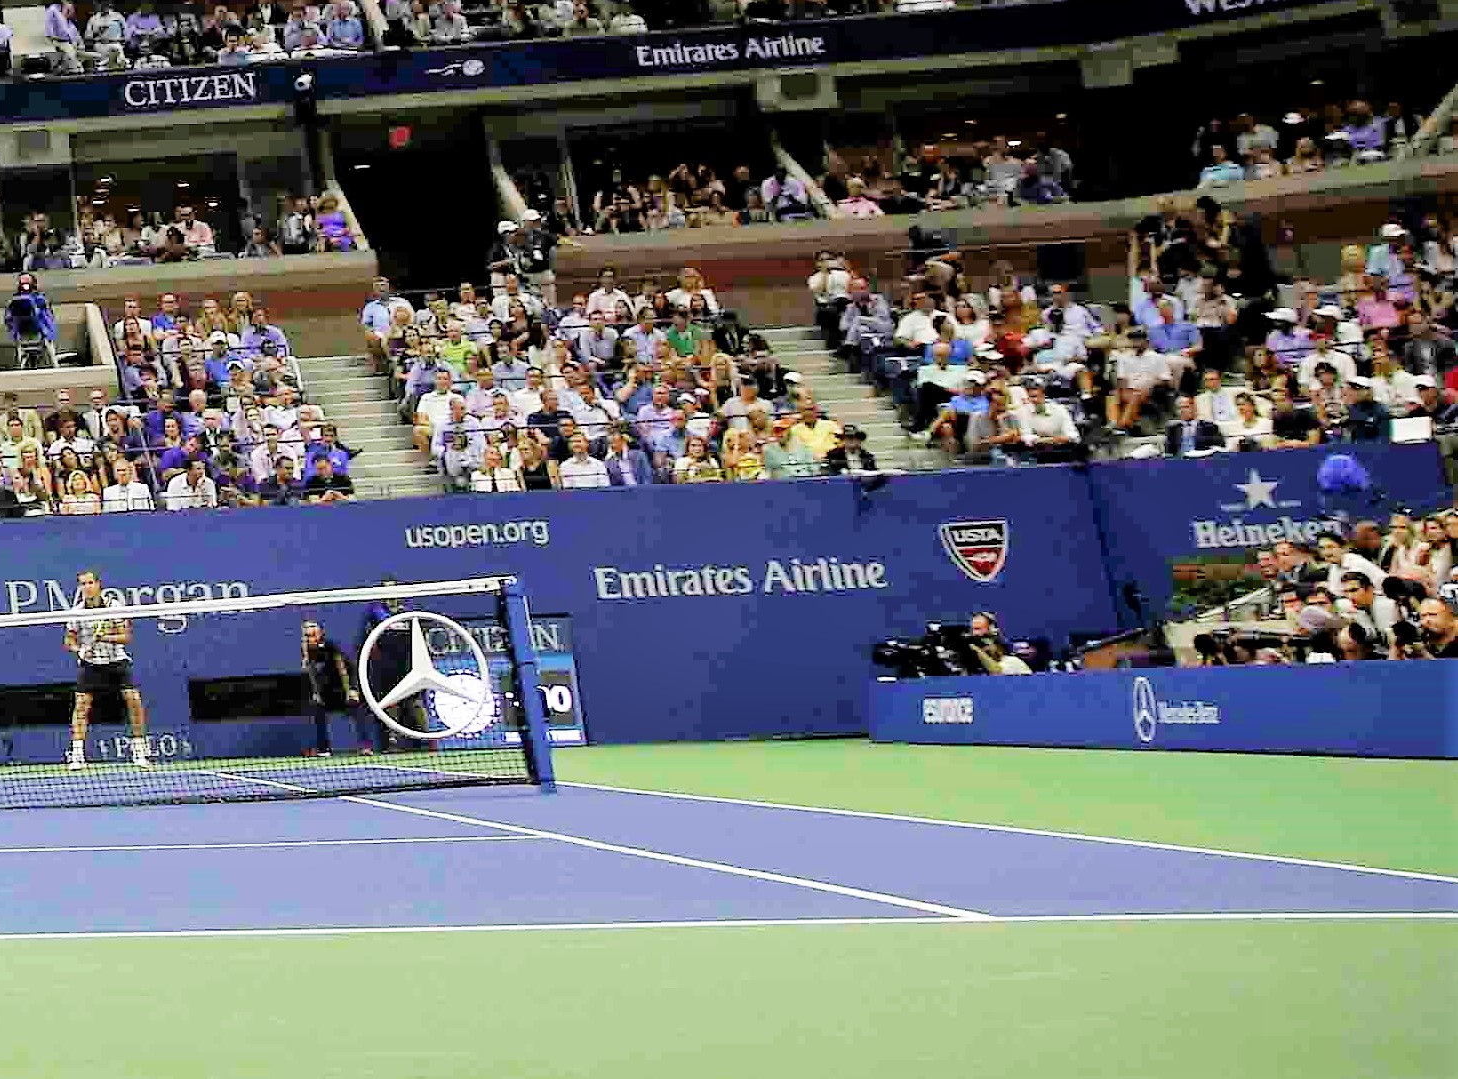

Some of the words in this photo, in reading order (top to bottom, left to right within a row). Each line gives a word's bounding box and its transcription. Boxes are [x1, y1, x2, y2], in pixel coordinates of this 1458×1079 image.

[636, 42, 740, 68] Emirates
[744, 31, 826, 59] Airline
[124, 72, 257, 108] CITIZEN
[405, 519, 550, 550] usopen.org
[953, 528, 1004, 544] USTA
[594, 563, 754, 601] Emirates
[764, 556, 888, 594] Airline
